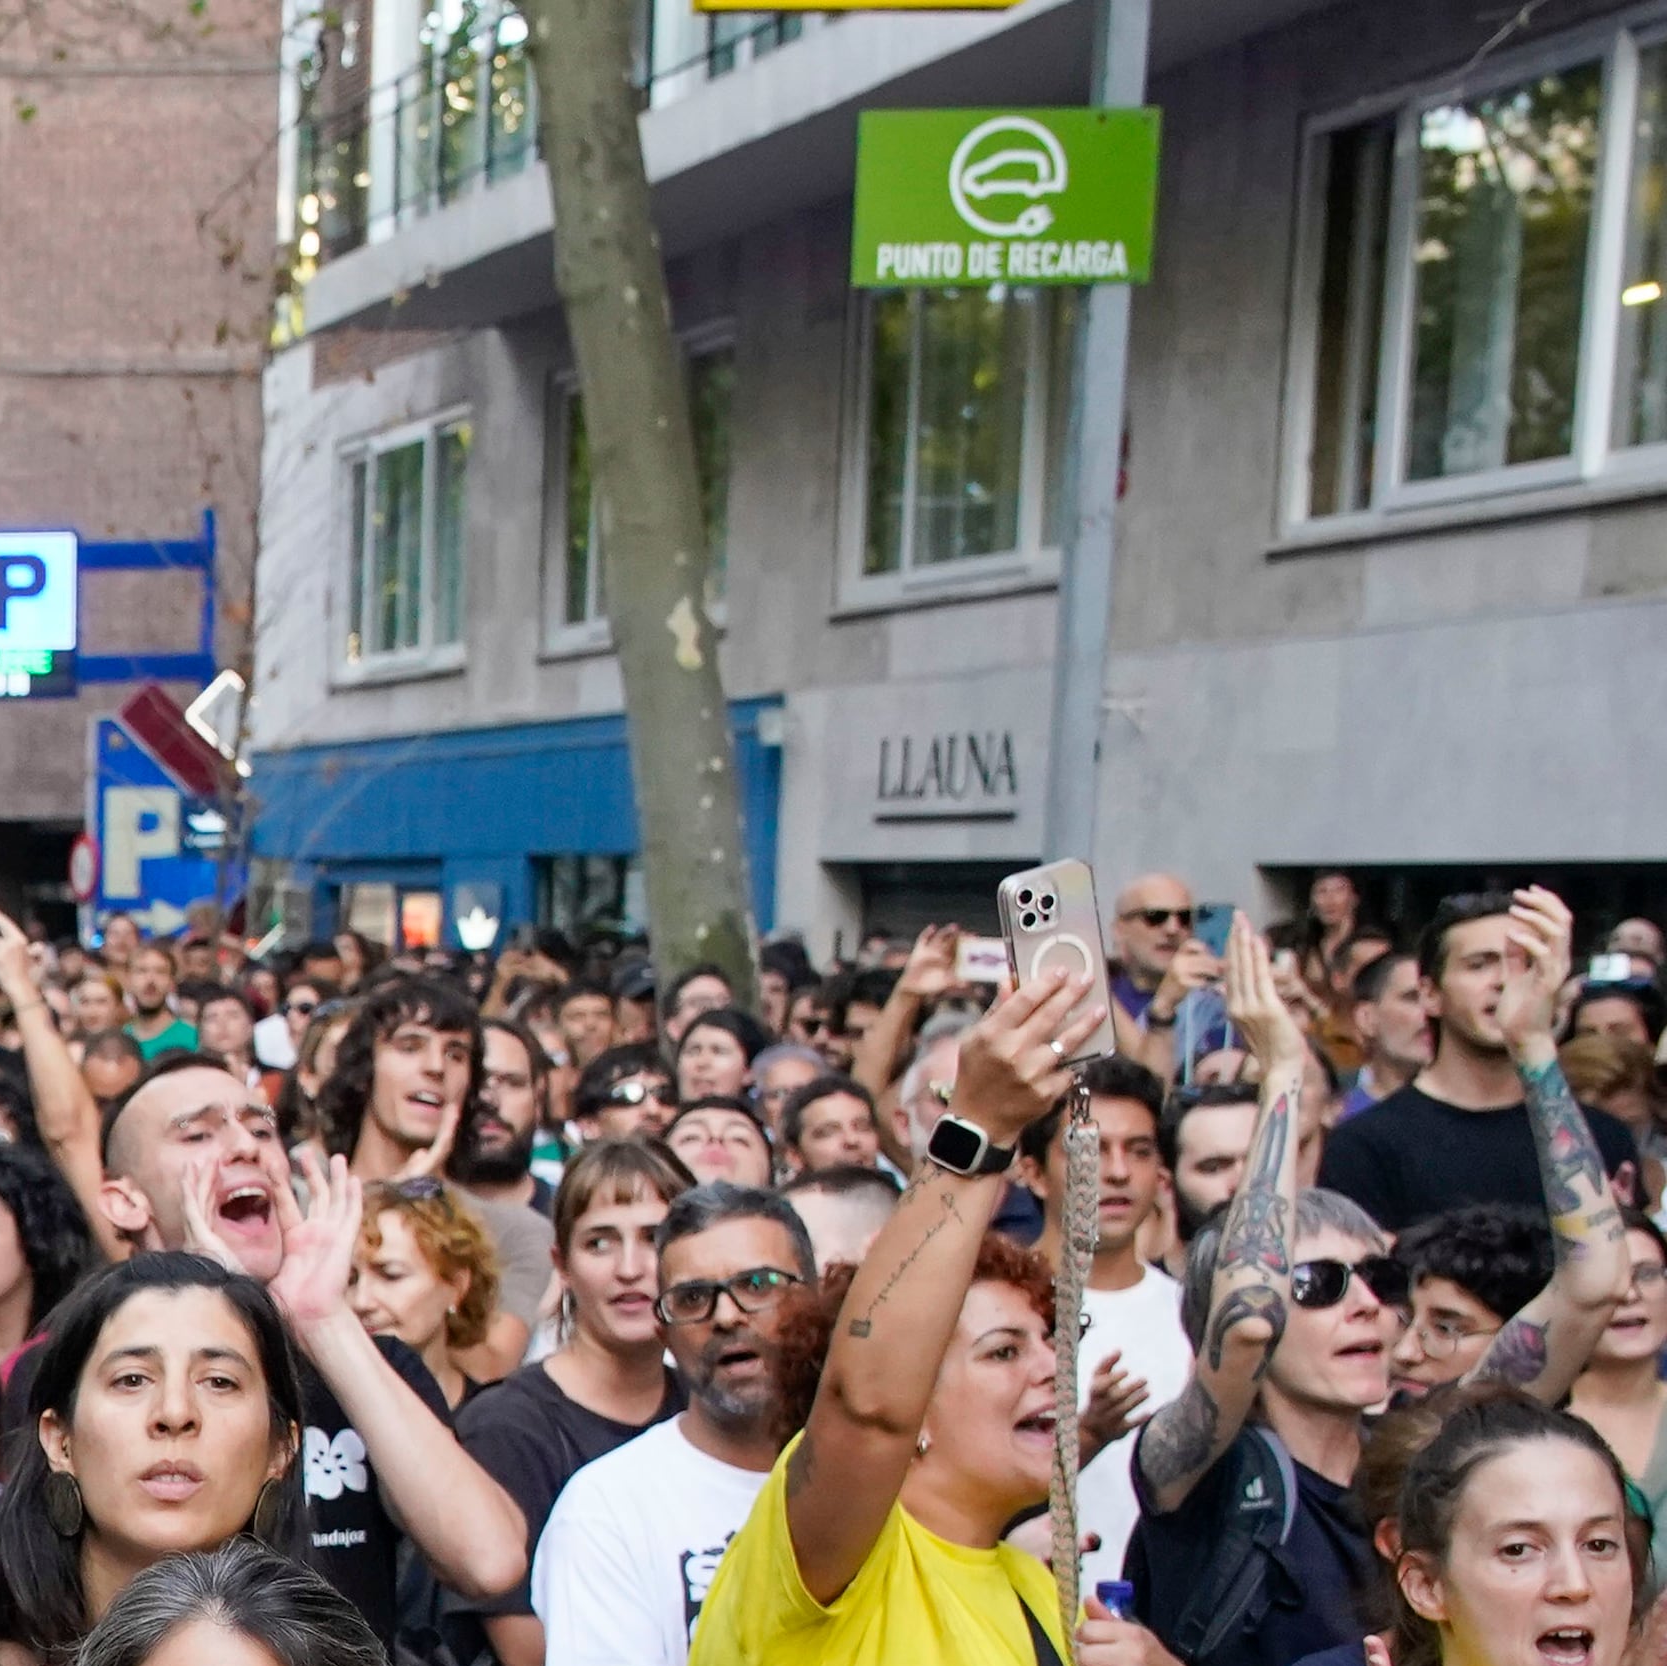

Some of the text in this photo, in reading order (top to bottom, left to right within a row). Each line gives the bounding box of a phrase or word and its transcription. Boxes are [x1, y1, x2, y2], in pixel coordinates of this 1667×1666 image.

[876, 239, 1129, 279] PUNTO DE RECARGA
[877, 731, 1017, 800] LLAUNA
[103, 786, 180, 899] P
